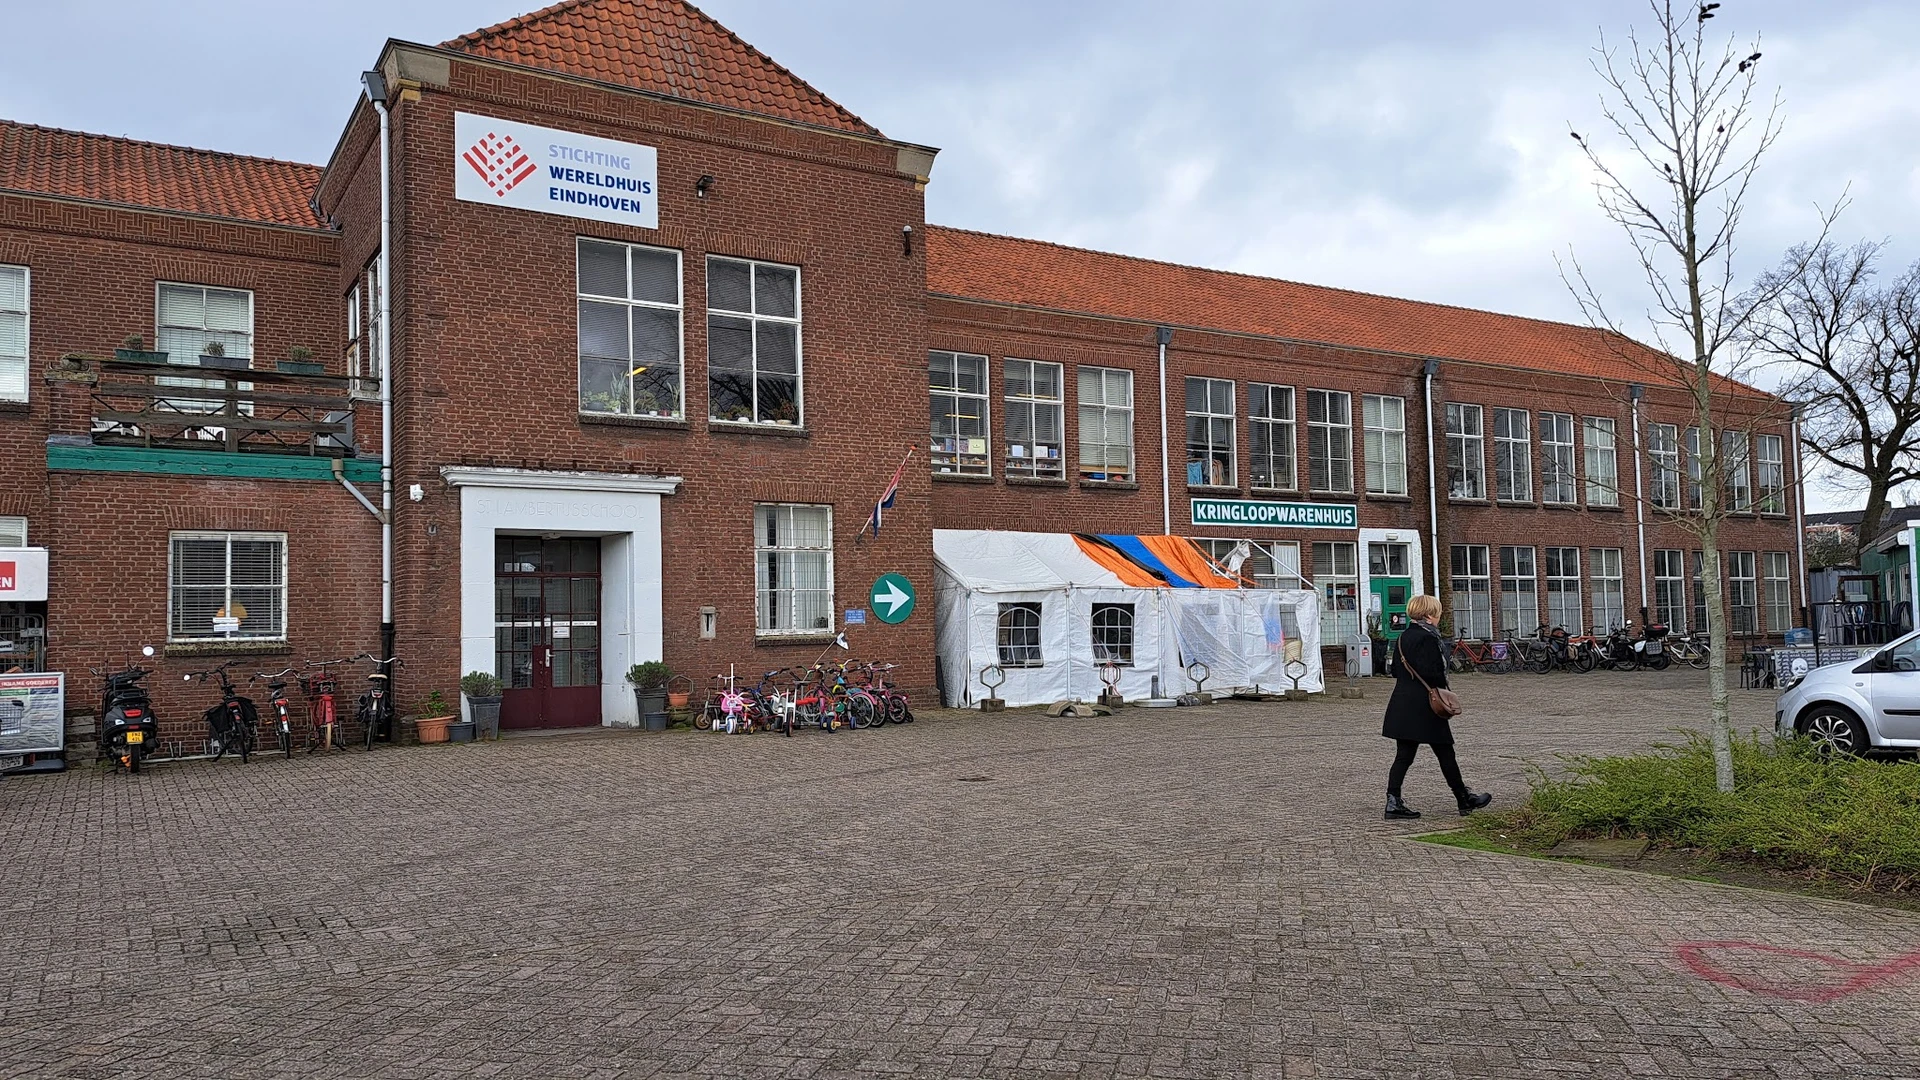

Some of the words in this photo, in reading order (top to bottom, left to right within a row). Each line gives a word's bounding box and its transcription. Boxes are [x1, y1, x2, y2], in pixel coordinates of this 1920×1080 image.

[549, 144, 631, 171] STICHTING
[549, 165, 652, 194] WERELDHUIS
[549, 187, 641, 214] EINDHOVEN
[497, 500, 645, 520] LAMBERTUSSCHOOL
[1196, 503, 1353, 524] KRINGLOOPWARENHUIS
